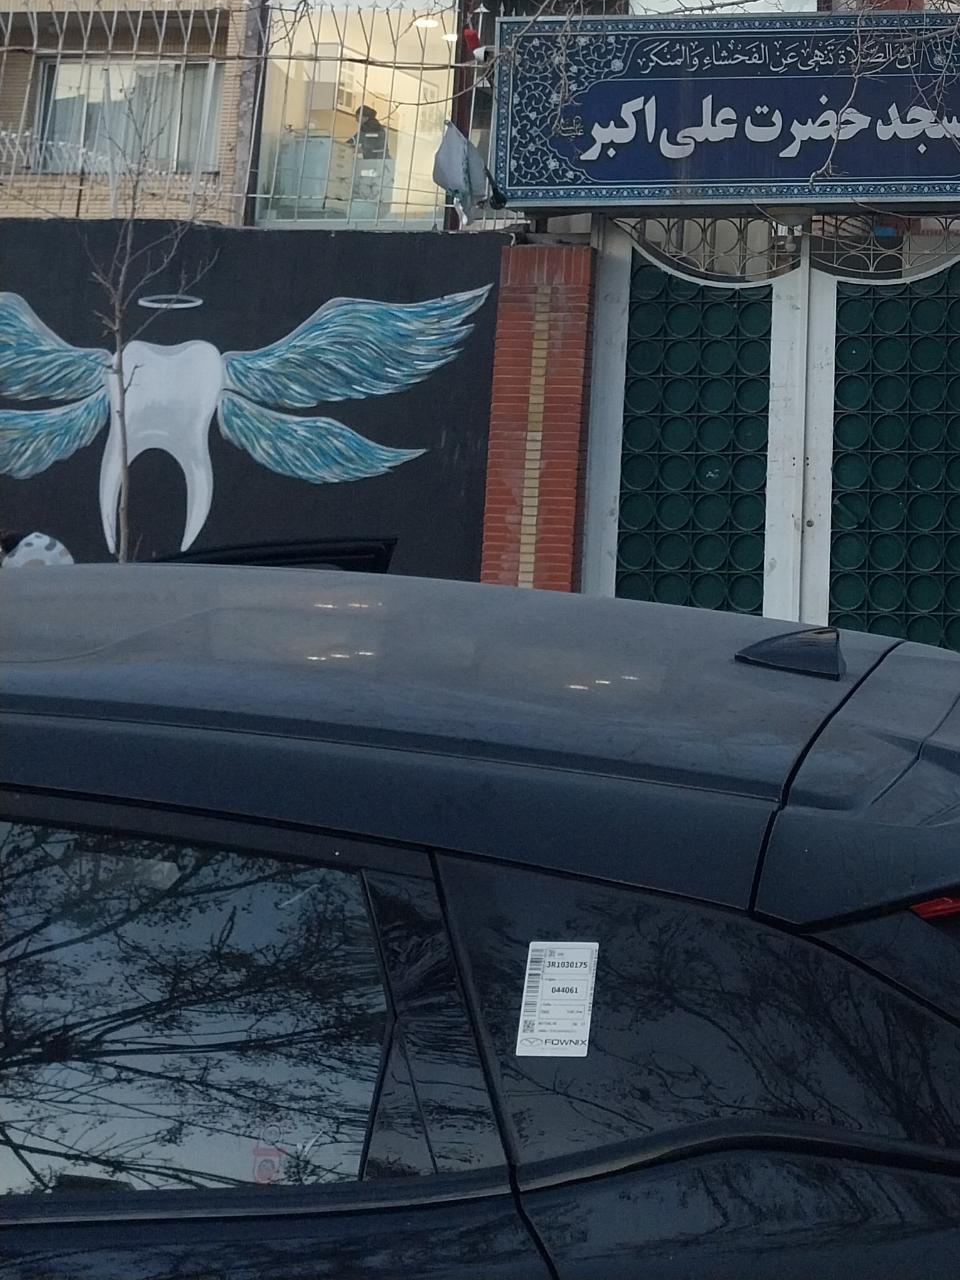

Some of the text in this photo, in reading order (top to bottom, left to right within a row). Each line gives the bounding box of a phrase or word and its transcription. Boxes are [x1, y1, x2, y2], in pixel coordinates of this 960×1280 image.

[580, 95, 656, 161] اکبر
[660, 94, 738, 159] علی
[745, 94, 873, 158] حضرت
